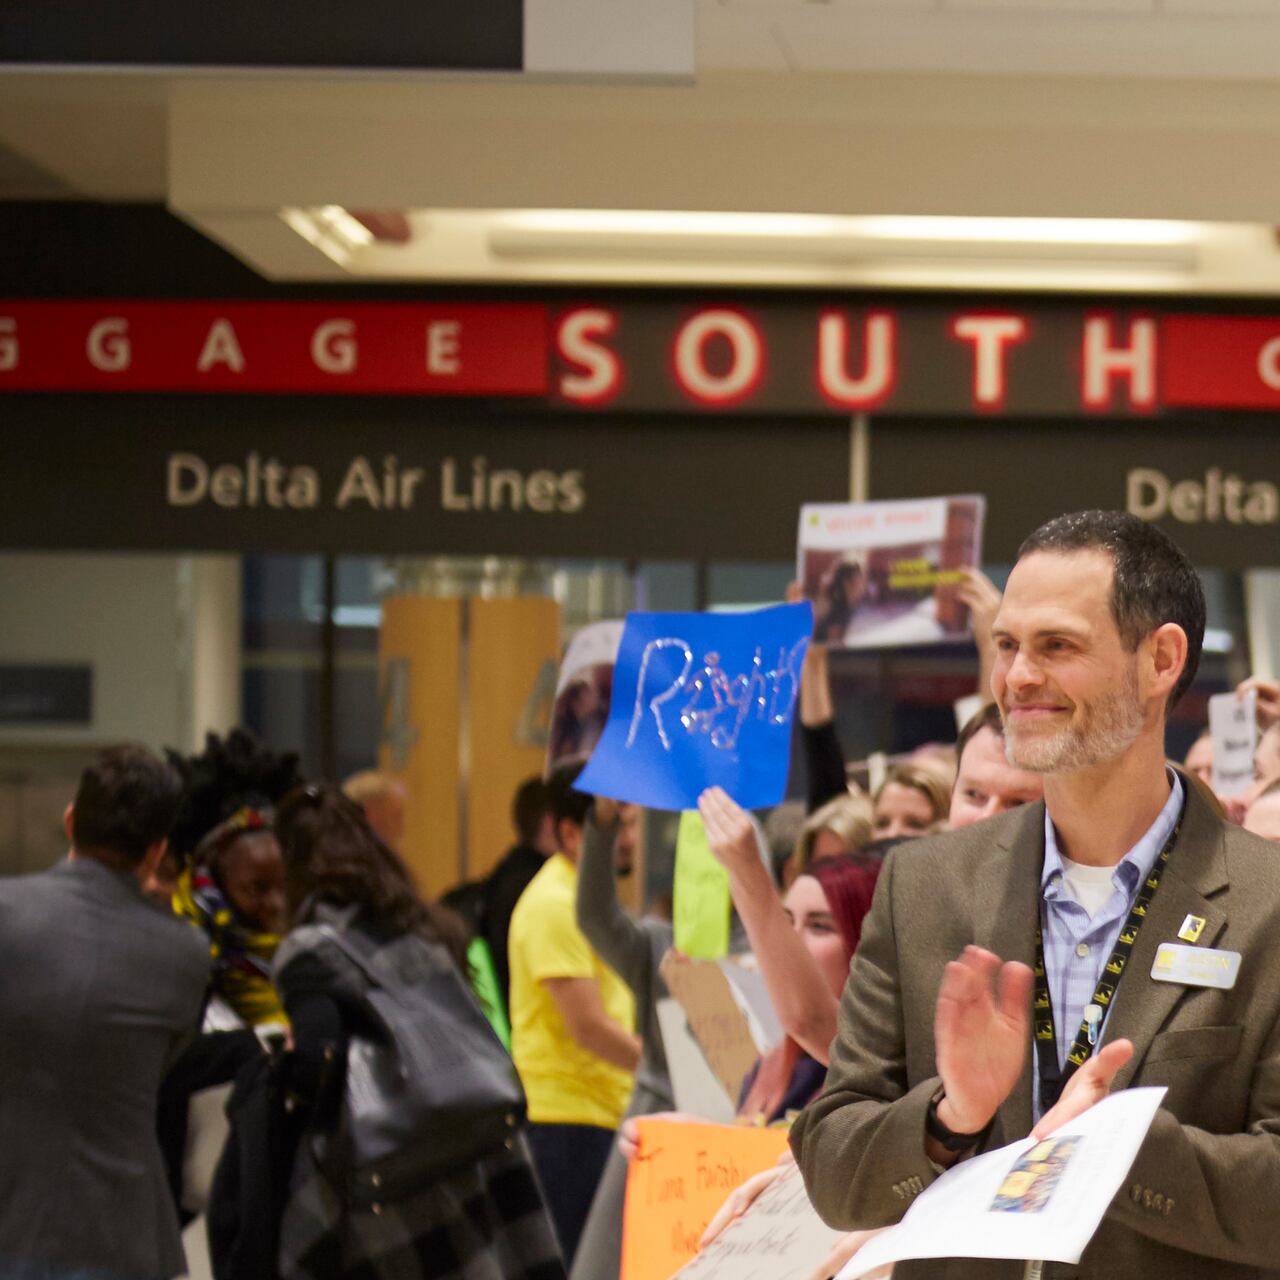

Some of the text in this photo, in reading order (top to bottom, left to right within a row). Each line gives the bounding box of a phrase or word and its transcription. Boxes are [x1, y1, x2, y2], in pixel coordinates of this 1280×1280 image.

[555, 307, 1160, 404] SOUTH
[166, 452, 585, 514] Delta Air Lines
[1126, 467, 1280, 525] Delta
